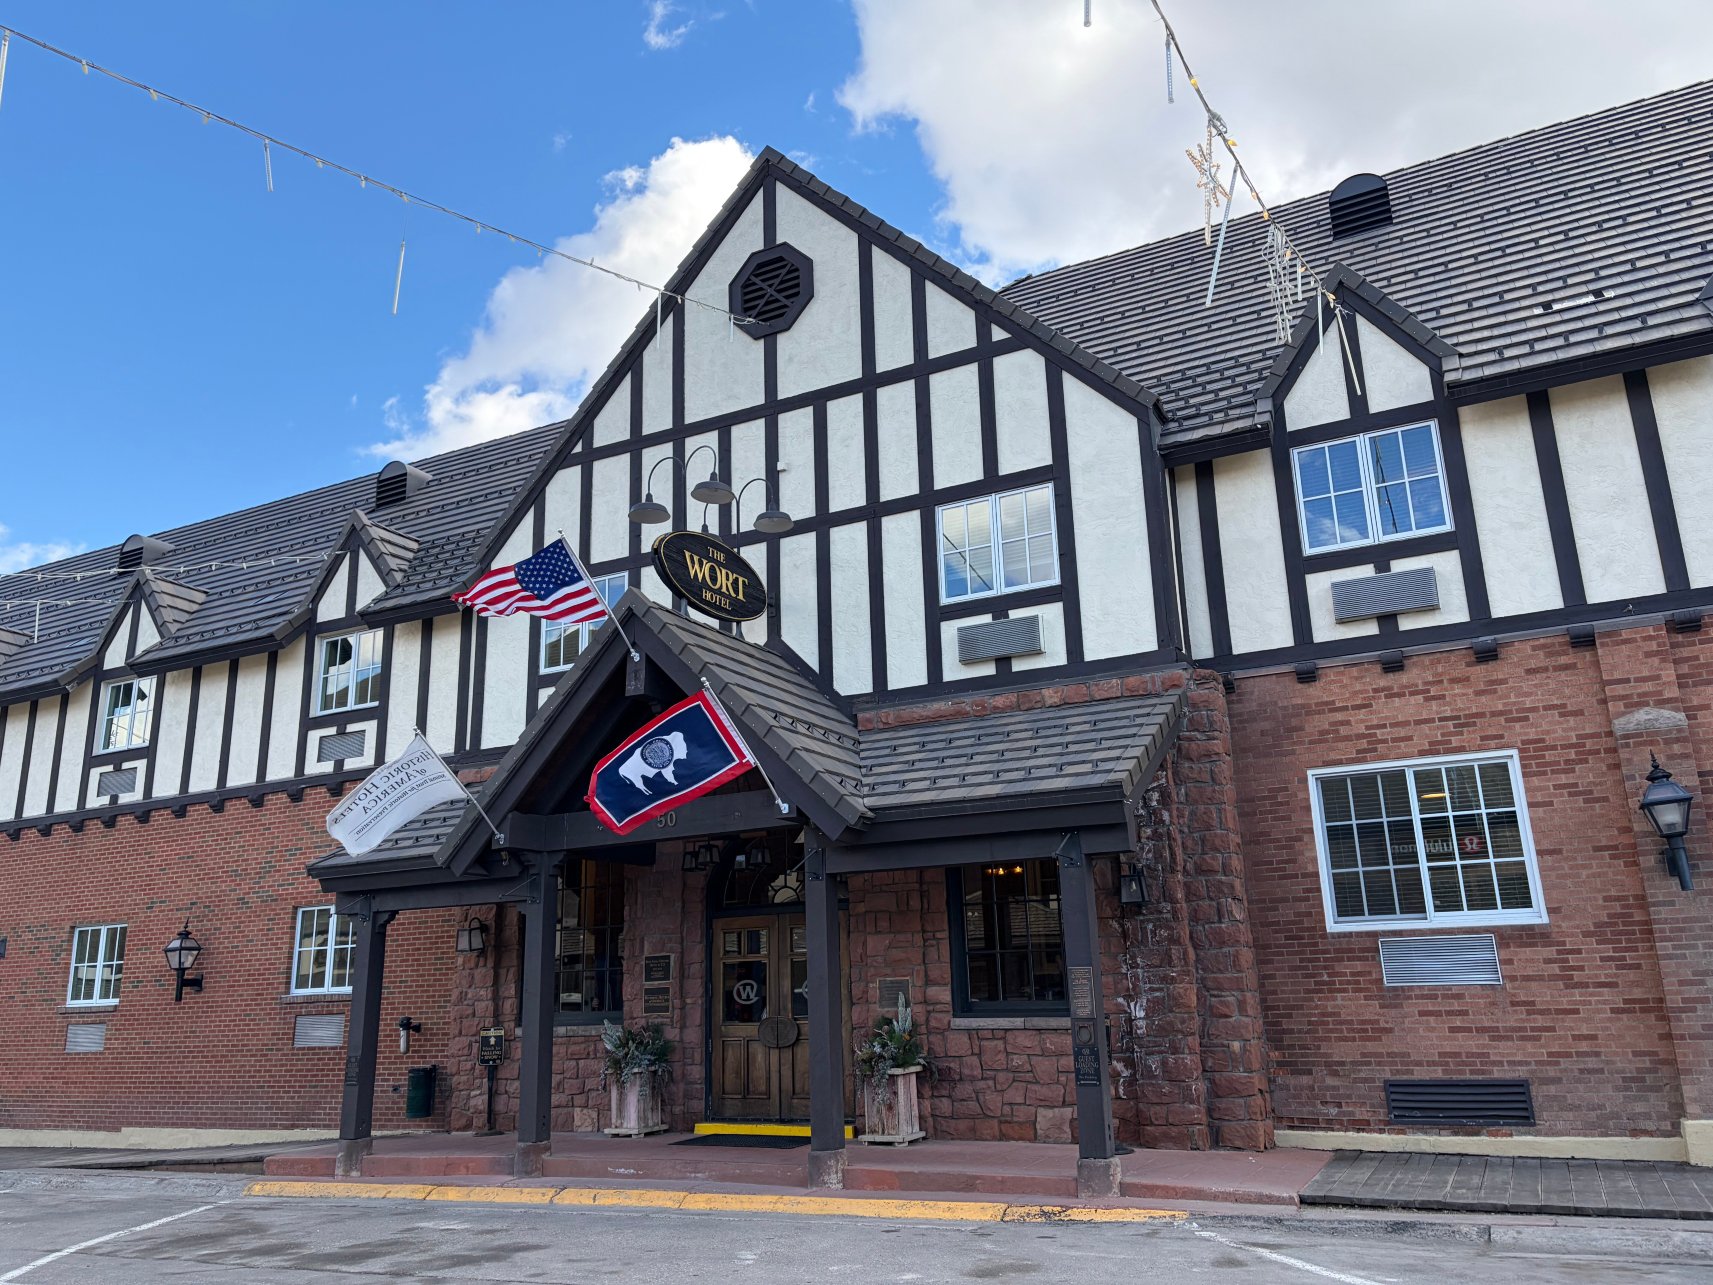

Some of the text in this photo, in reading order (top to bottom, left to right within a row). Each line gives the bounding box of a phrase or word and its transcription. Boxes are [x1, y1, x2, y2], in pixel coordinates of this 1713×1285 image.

[707, 546, 726, 563] THE
[683, 549, 749, 602] WORT
[702, 588, 732, 611] HOTEL
[656, 810, 677, 827] 50
